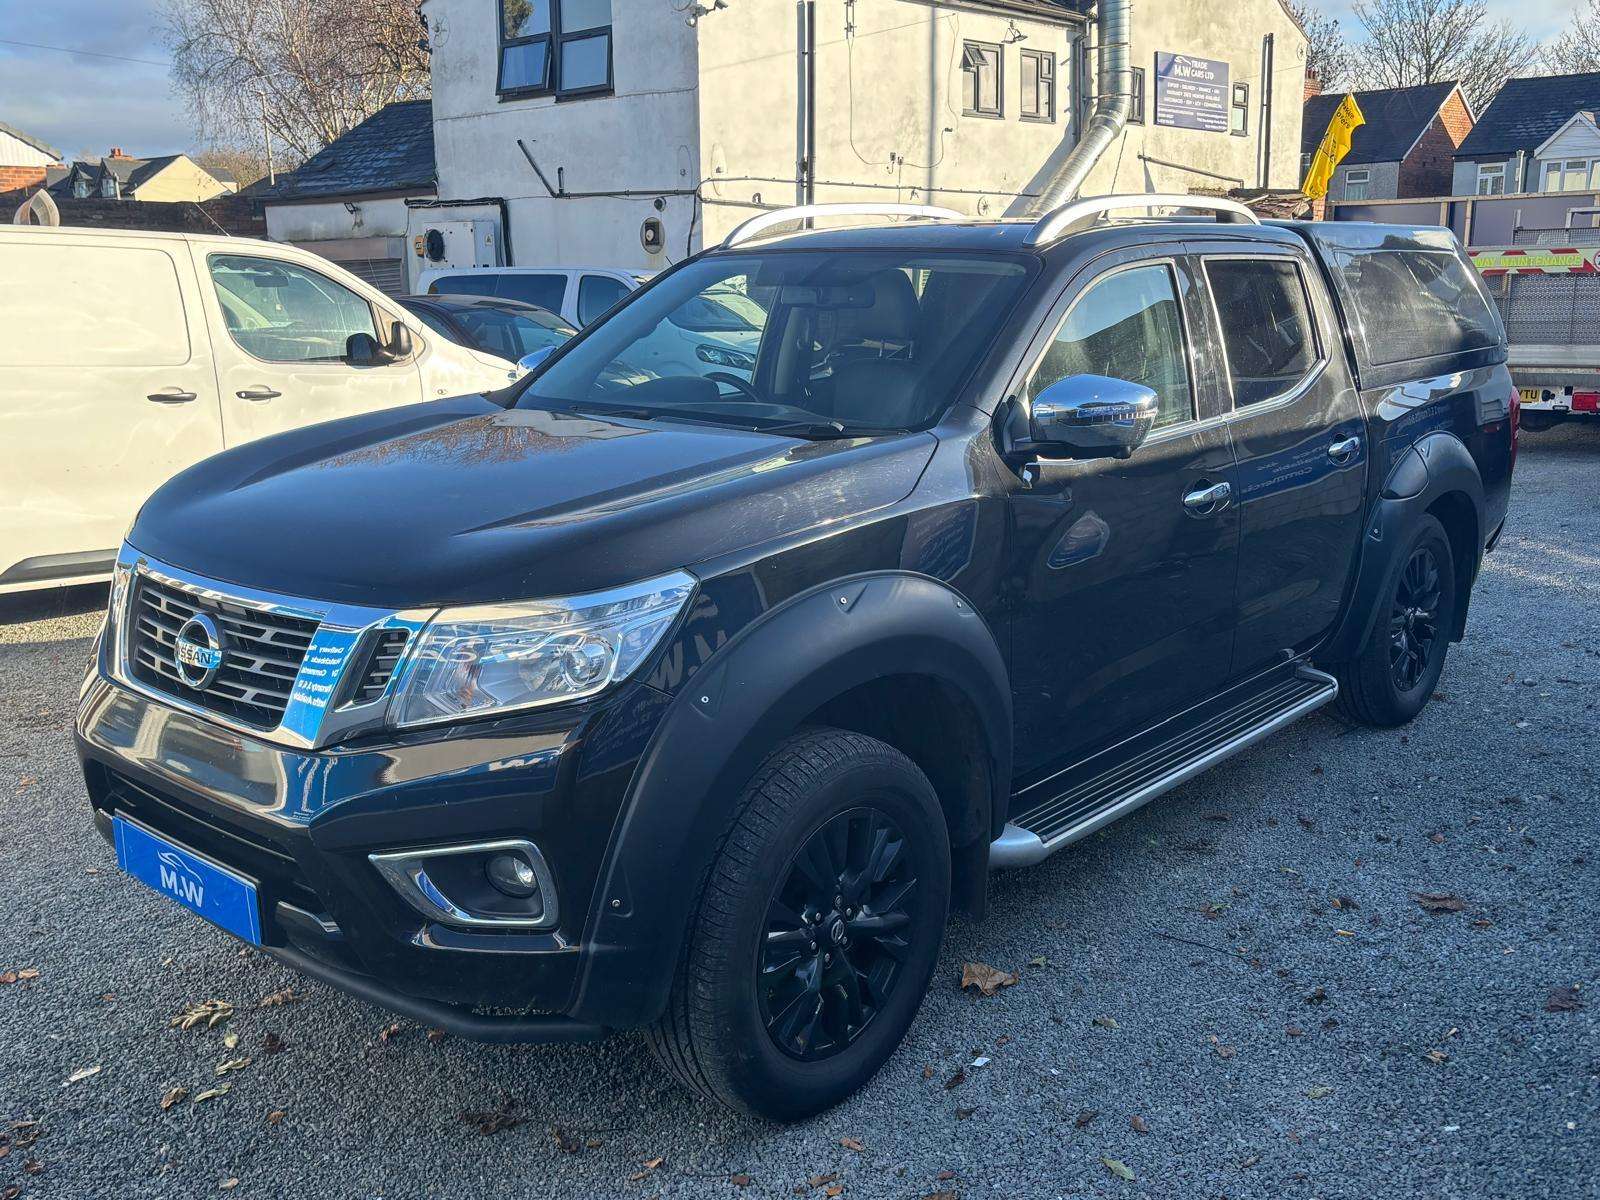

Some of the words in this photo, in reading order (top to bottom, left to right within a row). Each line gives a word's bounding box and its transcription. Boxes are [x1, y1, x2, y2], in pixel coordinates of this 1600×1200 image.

[1191, 60, 1208, 70] TRADE
[1191, 68, 1204, 79] CARS
[1204, 71, 1215, 81] LTD
[1500, 255, 1581, 267] MAINTENANCE
[159, 864, 204, 908] M.W
